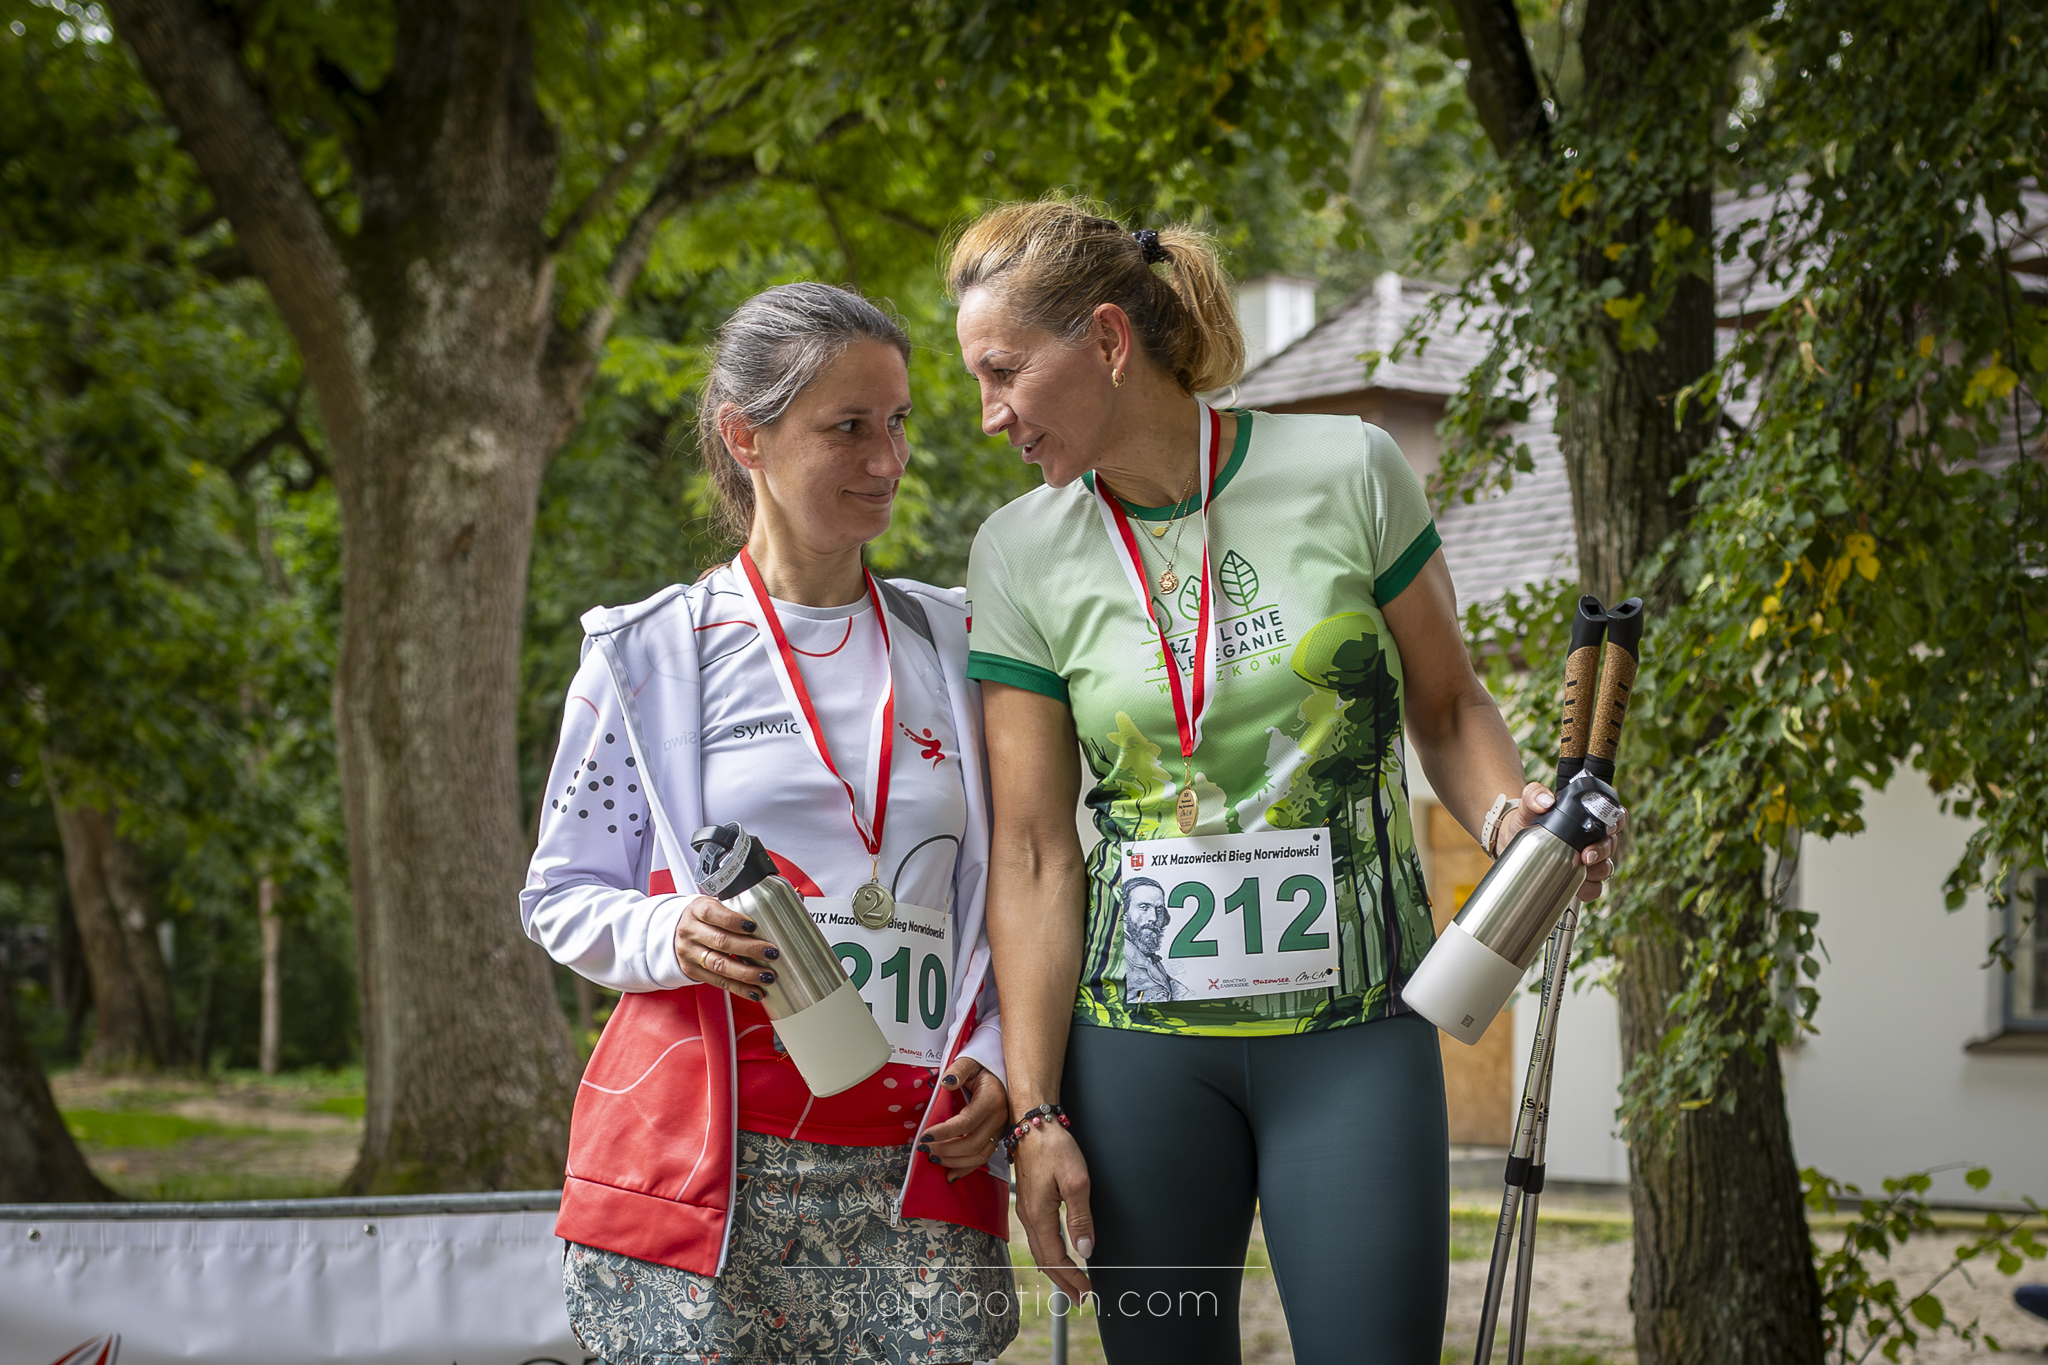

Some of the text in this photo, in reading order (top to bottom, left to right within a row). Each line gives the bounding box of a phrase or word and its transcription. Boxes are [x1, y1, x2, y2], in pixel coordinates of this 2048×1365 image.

[1151, 845, 1319, 866] XIX Mazowiecki Bieg Norwidowski
[863, 890, 884, 920] 2
[1167, 874, 1330, 959] 212
[908, 920, 945, 939] Norwidowski
